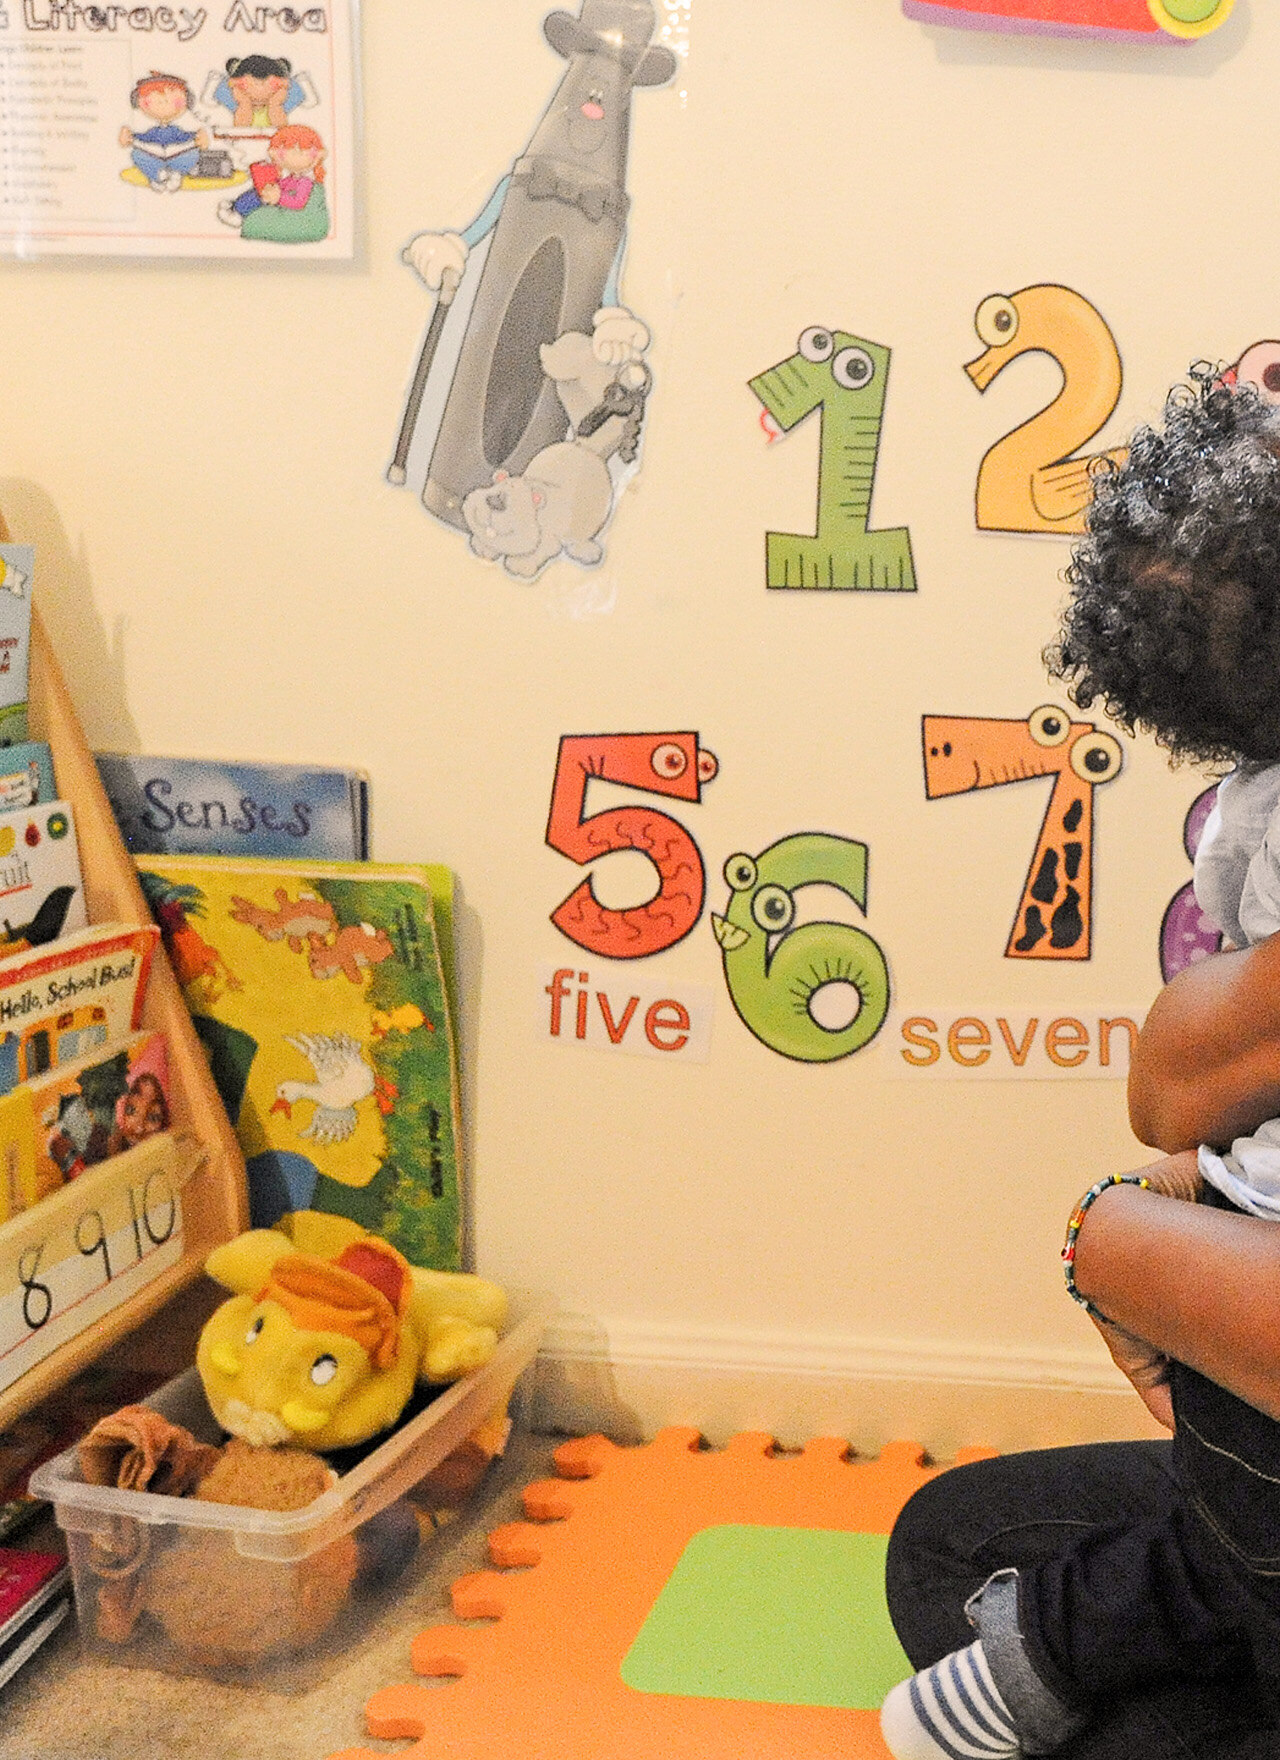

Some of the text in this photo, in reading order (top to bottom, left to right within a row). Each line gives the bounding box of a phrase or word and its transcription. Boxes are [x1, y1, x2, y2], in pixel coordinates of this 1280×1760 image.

[24, 0, 206, 41] Literacy
[224, 0, 327, 33] Area
[142, 777, 312, 838] Senses
[47, 968, 97, 1006] School
[546, 968, 692, 1051] five
[900, 1013, 1140, 1067] seven
[19, 1242, 52, 1329] 8
[75, 1209, 112, 1281] 9
[128, 1168, 176, 1259] 10
